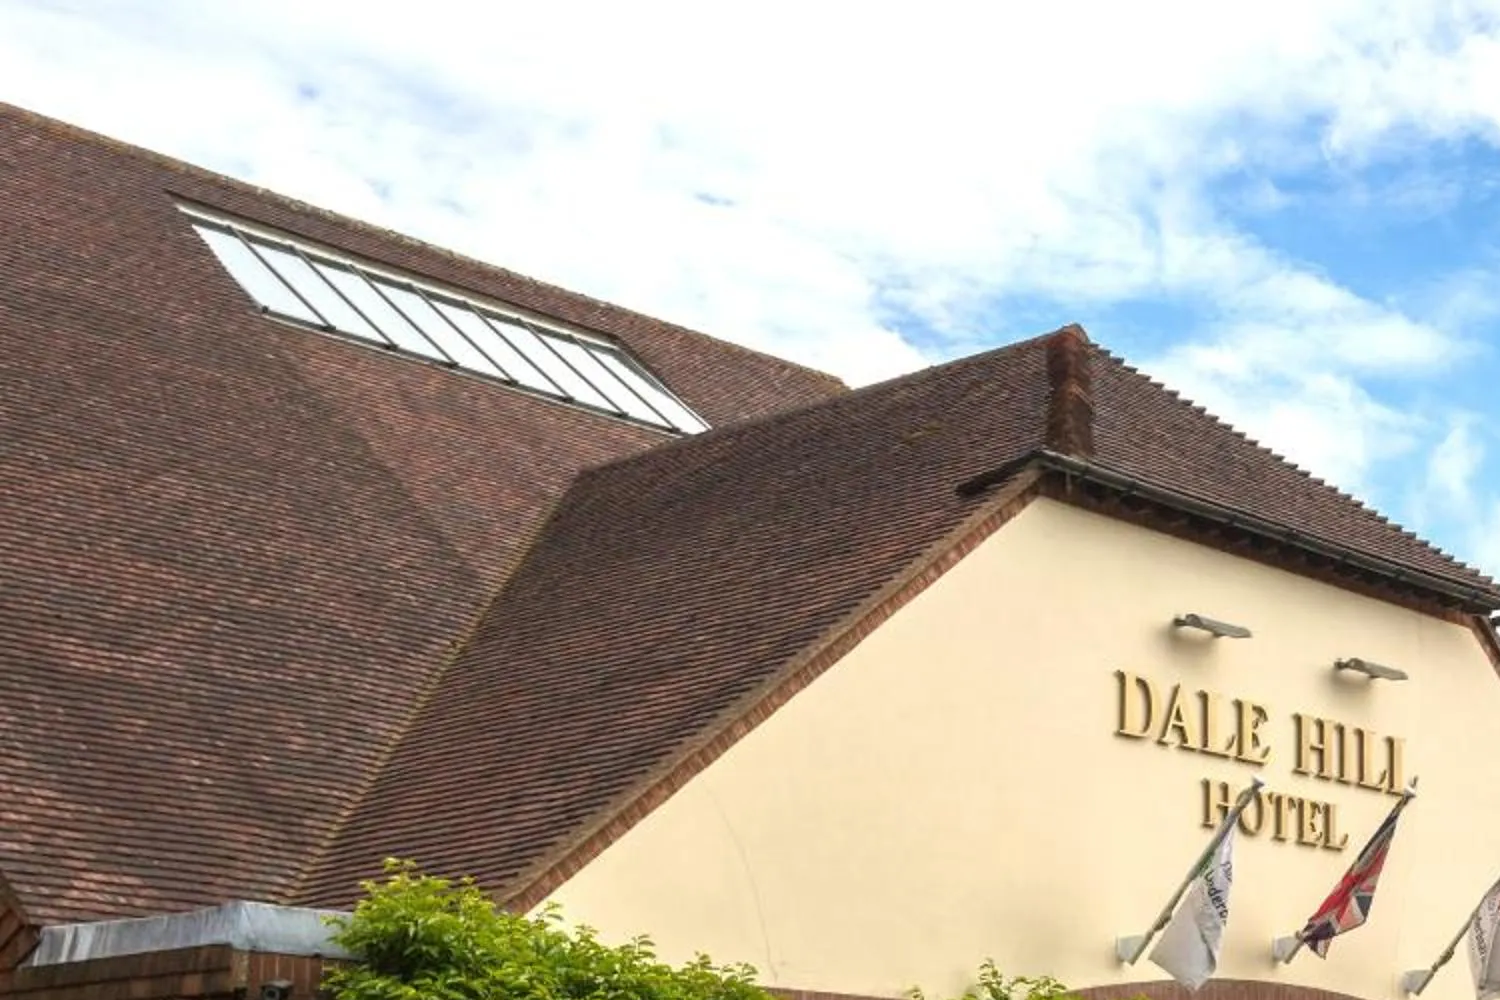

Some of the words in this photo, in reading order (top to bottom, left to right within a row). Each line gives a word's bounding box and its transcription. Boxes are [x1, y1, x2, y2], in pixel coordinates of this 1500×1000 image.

[1114, 668, 1271, 766] DALE
[1292, 712, 1416, 797] HILL
[1200, 777, 1348, 851] HOTEL
